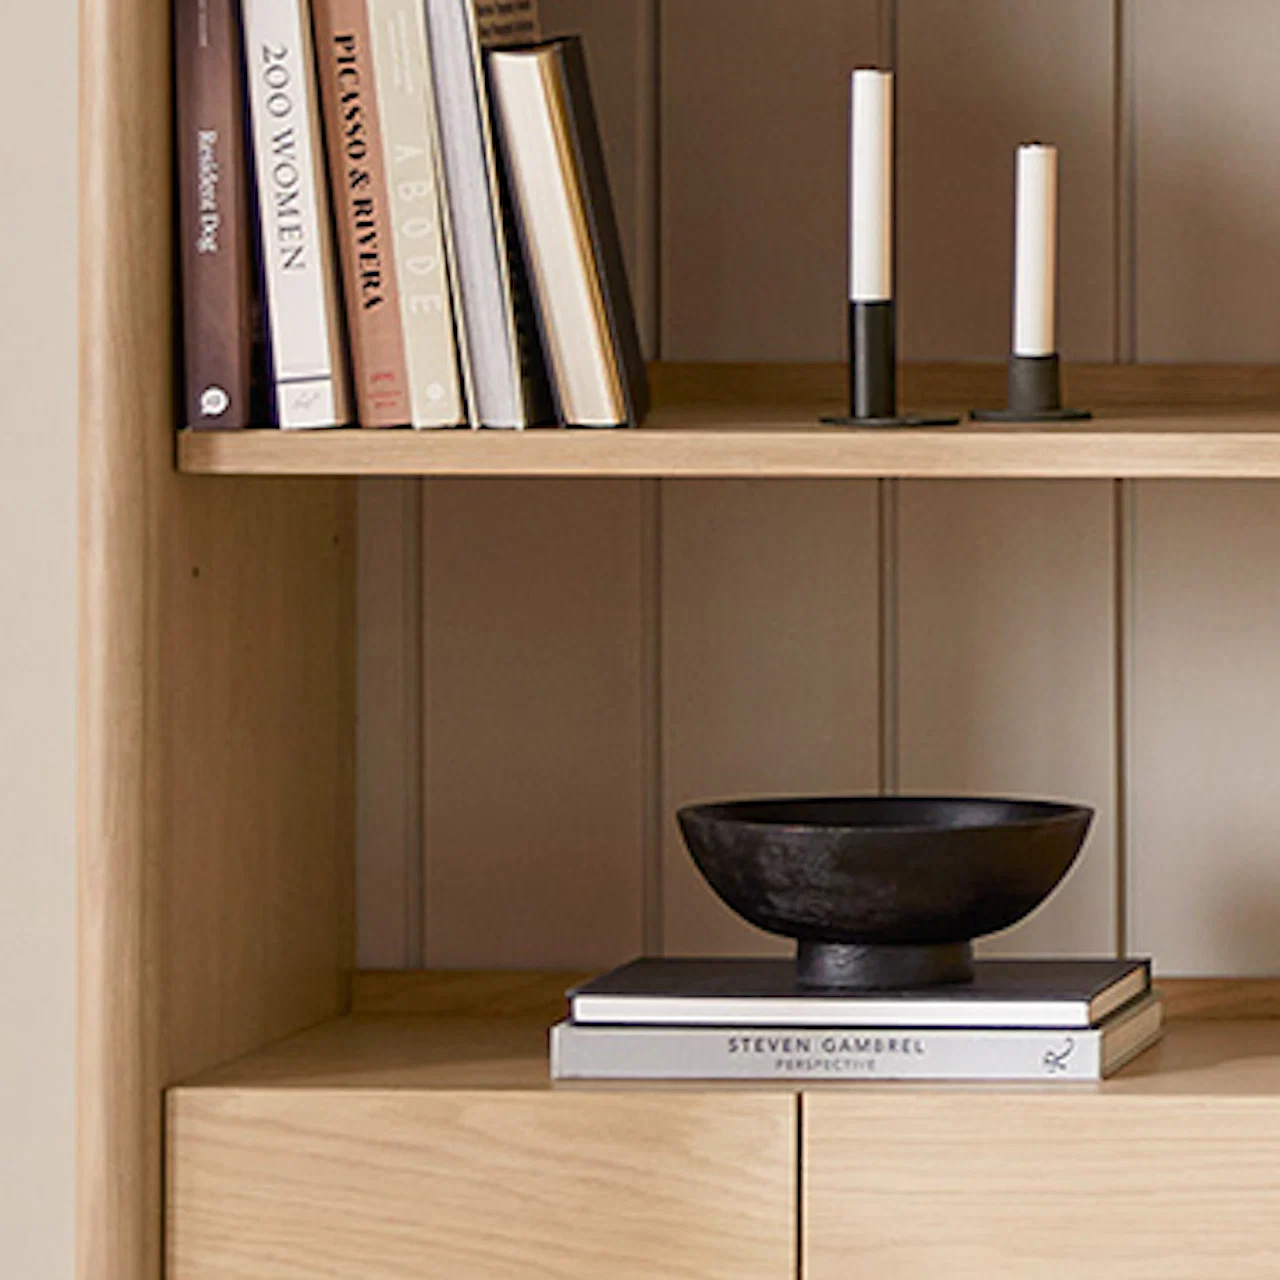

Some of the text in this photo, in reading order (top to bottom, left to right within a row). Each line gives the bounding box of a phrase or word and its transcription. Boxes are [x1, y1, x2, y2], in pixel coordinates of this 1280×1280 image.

[196, 130, 220, 253] Resident Dog
[262, 45, 306, 270] 200 WOMEN
[334, 35, 384, 309] PICASSO & RIVERA
[393, 144, 443, 314] ABODE
[728, 1037, 926, 1054] STEVEN GAMBREL
[775, 1059, 876, 1071] PERSPECTIVE
